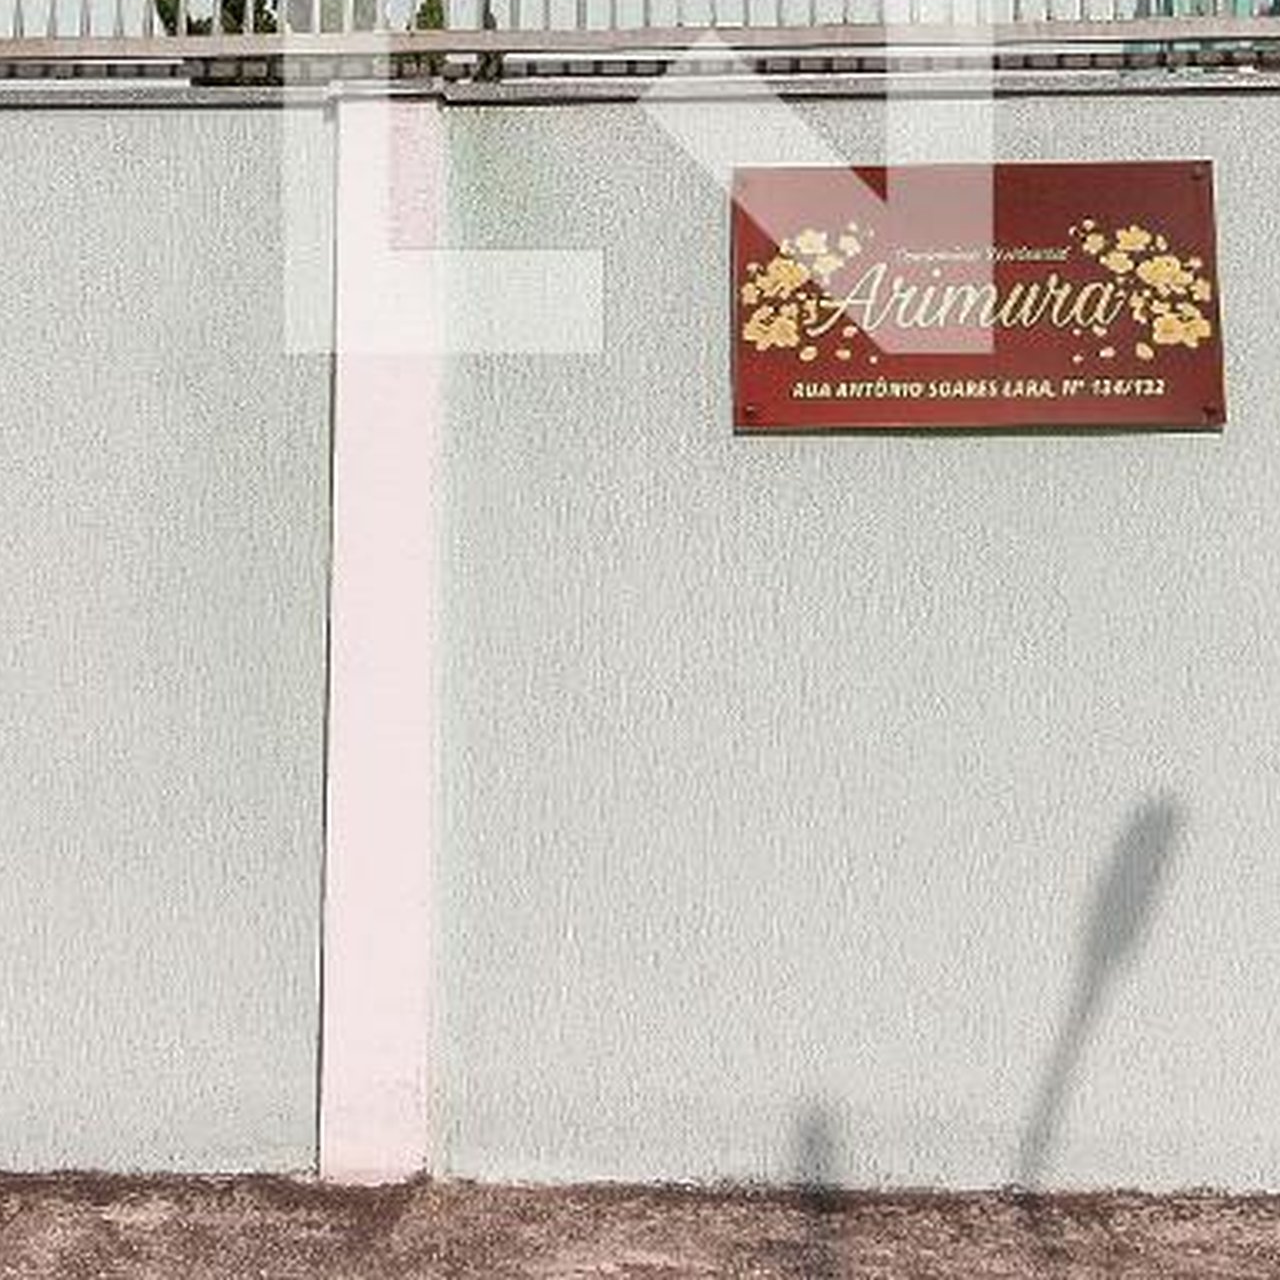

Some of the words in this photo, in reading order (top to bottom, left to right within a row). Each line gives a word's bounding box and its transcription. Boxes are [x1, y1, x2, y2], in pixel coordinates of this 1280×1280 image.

[807, 262, 1122, 336] Arimura
[792, 381, 832, 398] RUA
[927, 379, 998, 398] SOARES
